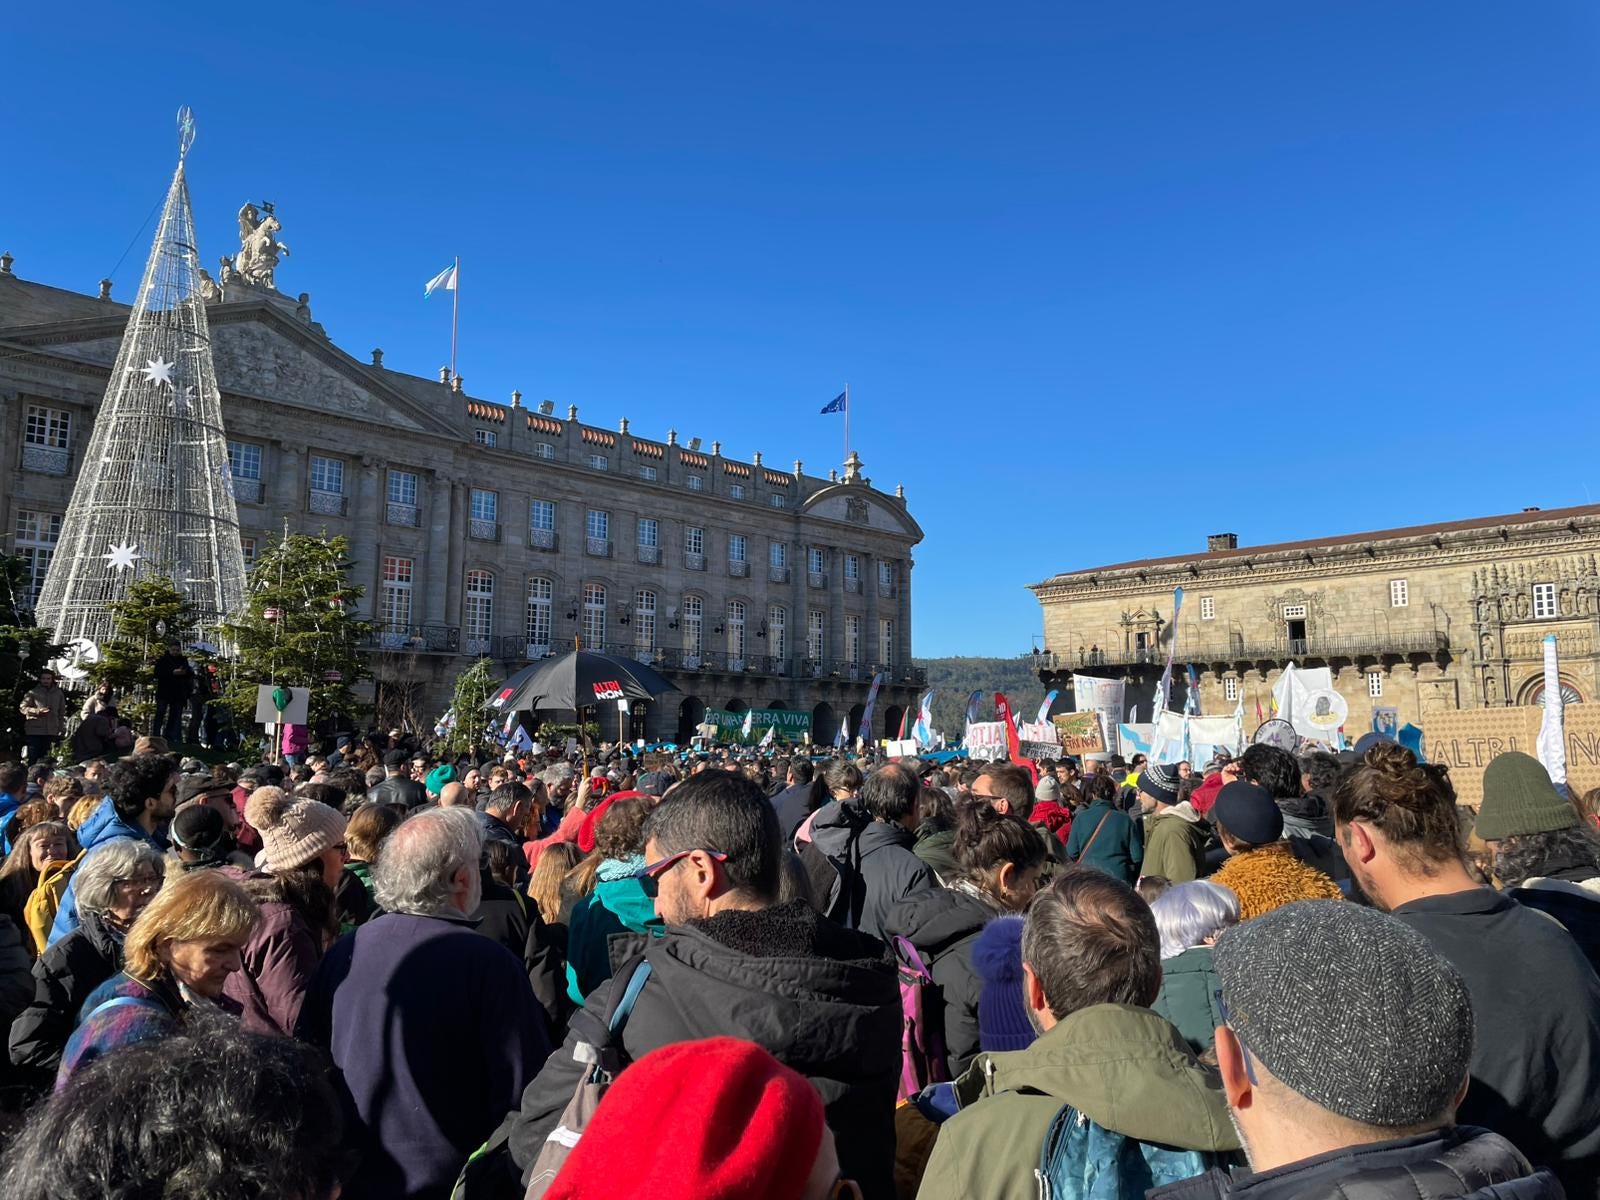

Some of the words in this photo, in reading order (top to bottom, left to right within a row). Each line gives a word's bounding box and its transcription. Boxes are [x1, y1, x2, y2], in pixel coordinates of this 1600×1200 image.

[592, 680, 621, 694] ALTRI
[595, 689, 625, 701] NON
[782, 712, 810, 727] VIVA
[1432, 735, 1518, 768] ALTRI
[1568, 732, 1600, 767] N
